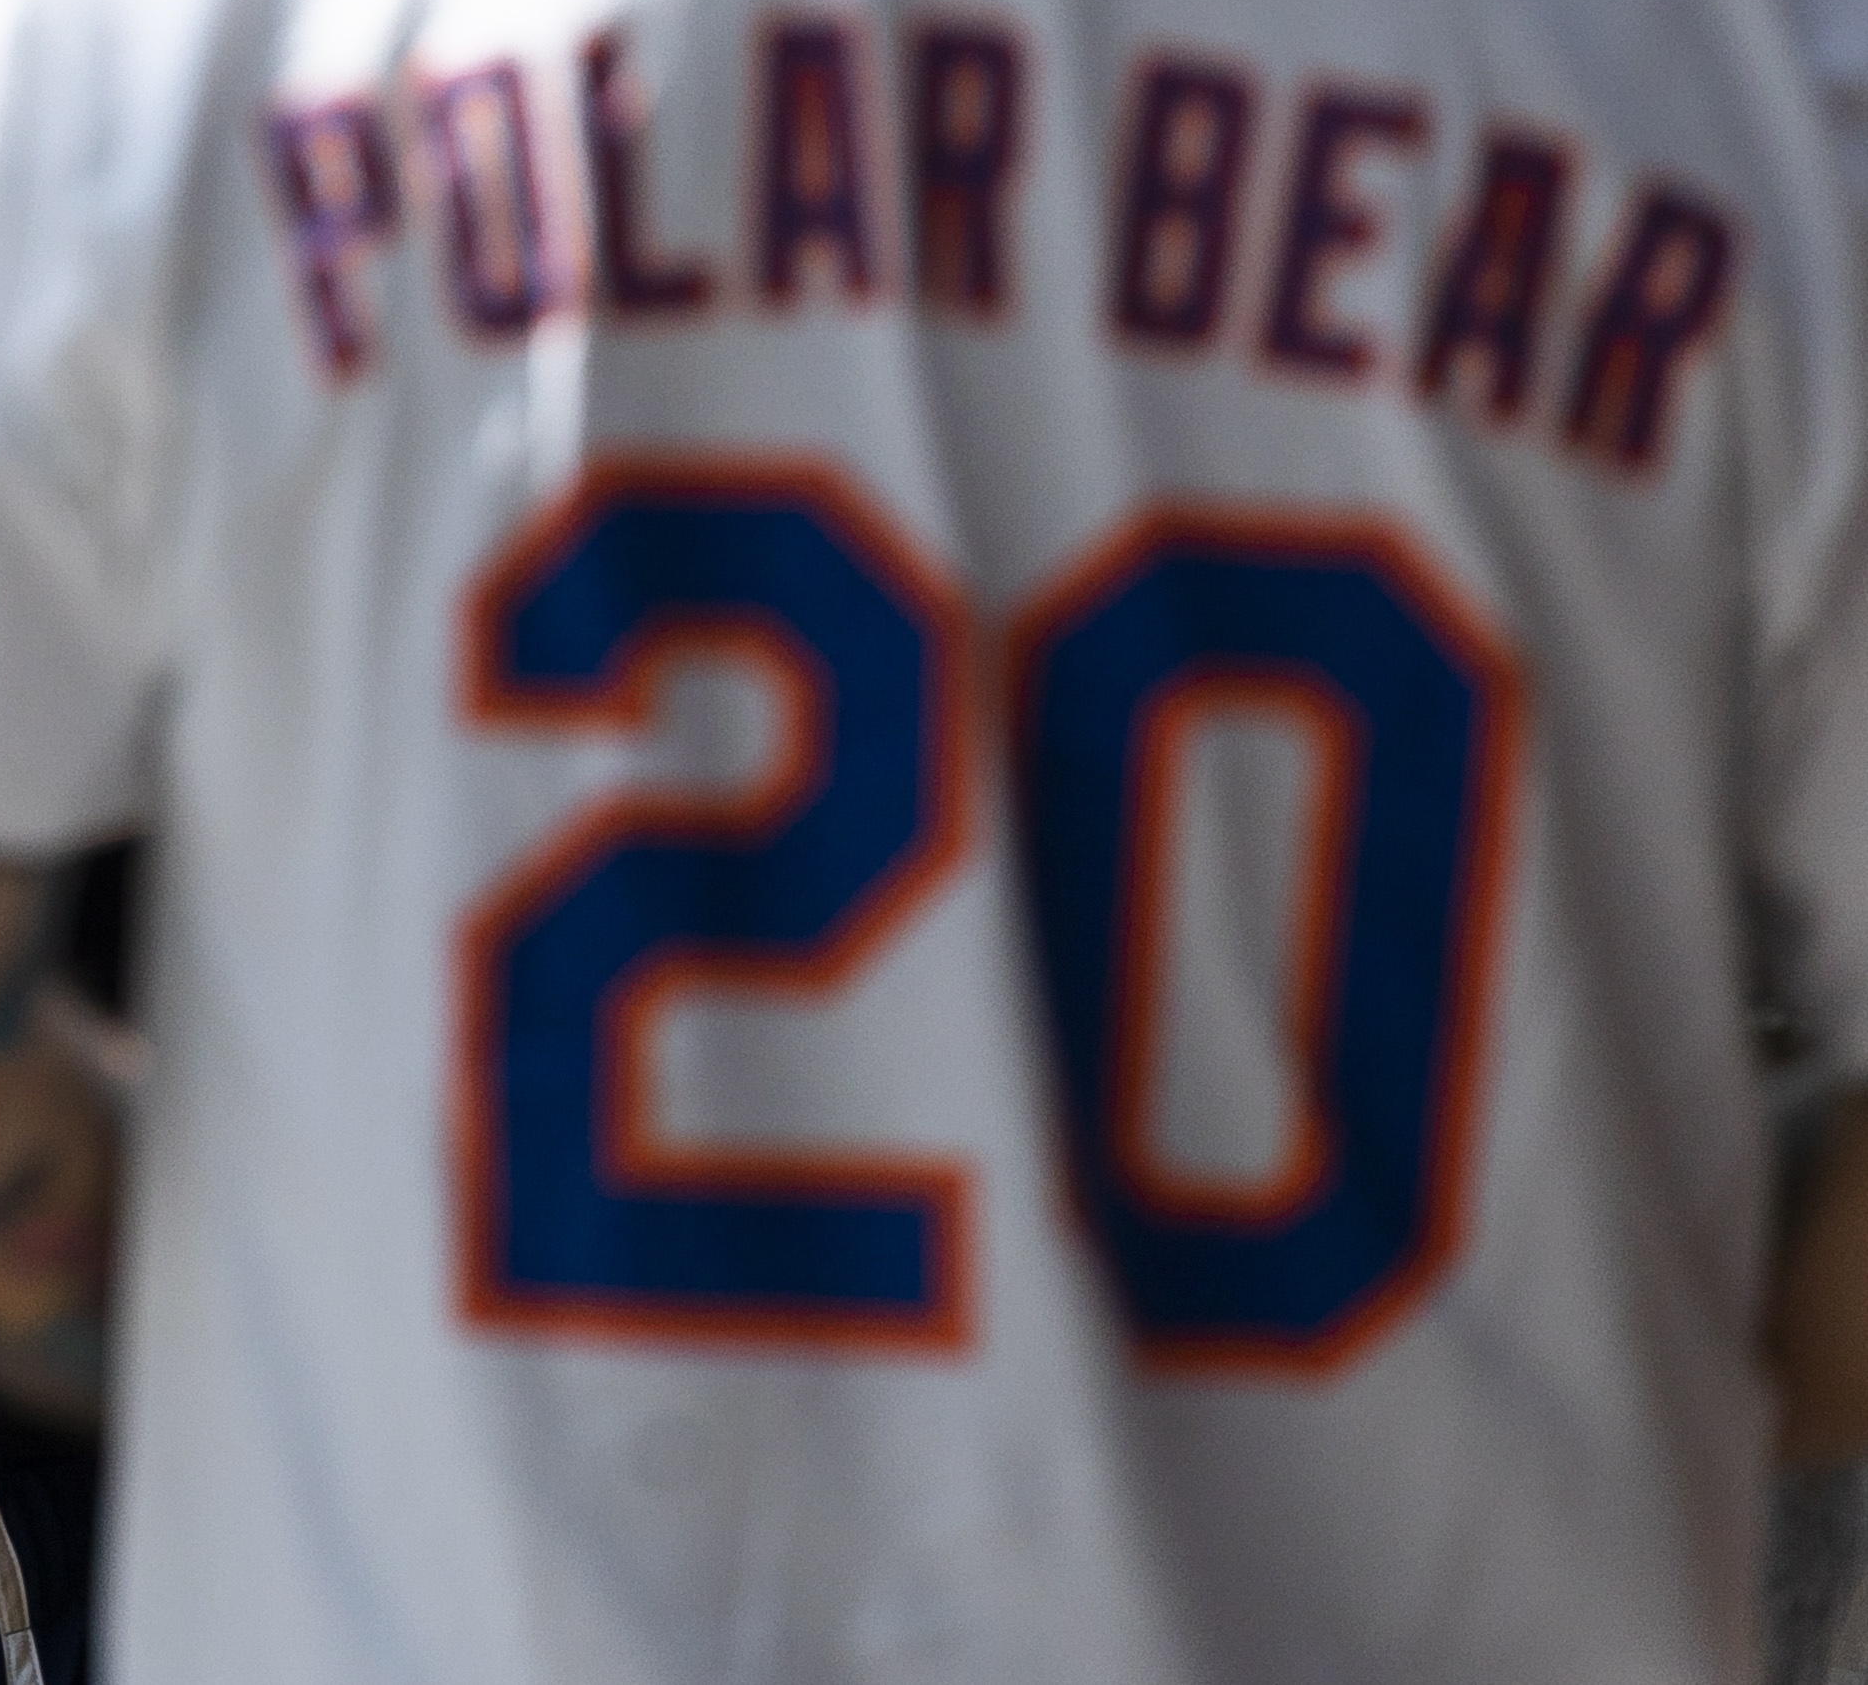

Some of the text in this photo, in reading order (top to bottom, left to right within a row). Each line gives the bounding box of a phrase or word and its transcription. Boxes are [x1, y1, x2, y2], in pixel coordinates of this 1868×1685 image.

[260, 10, 1739, 478] POLAR BEAR
[451, 454, 1525, 1384] 20
